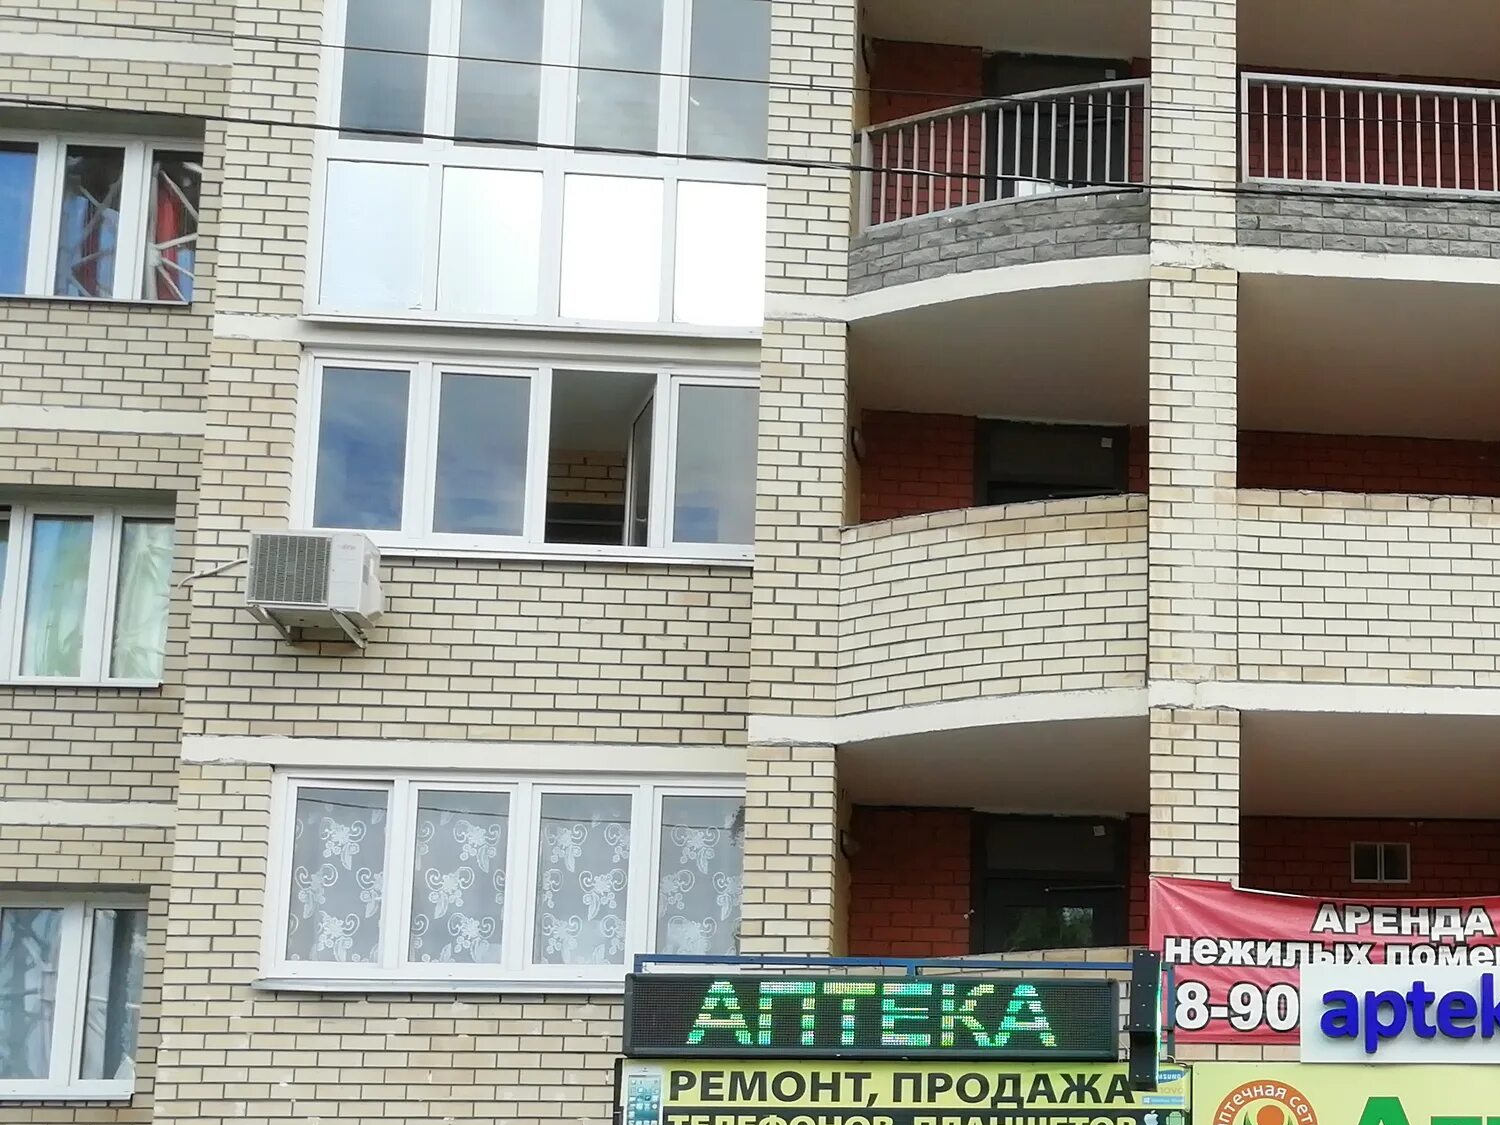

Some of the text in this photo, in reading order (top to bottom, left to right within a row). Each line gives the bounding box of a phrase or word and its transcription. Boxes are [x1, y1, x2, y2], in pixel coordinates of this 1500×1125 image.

[1312, 904, 1496, 941] АРЕНДА
[1164, 936, 1374, 966] нежилых
[687, 980, 1057, 1047] АПТЕКА
[669, 1070, 1135, 1109] РЕМОНТ, ПРОДАЖА
